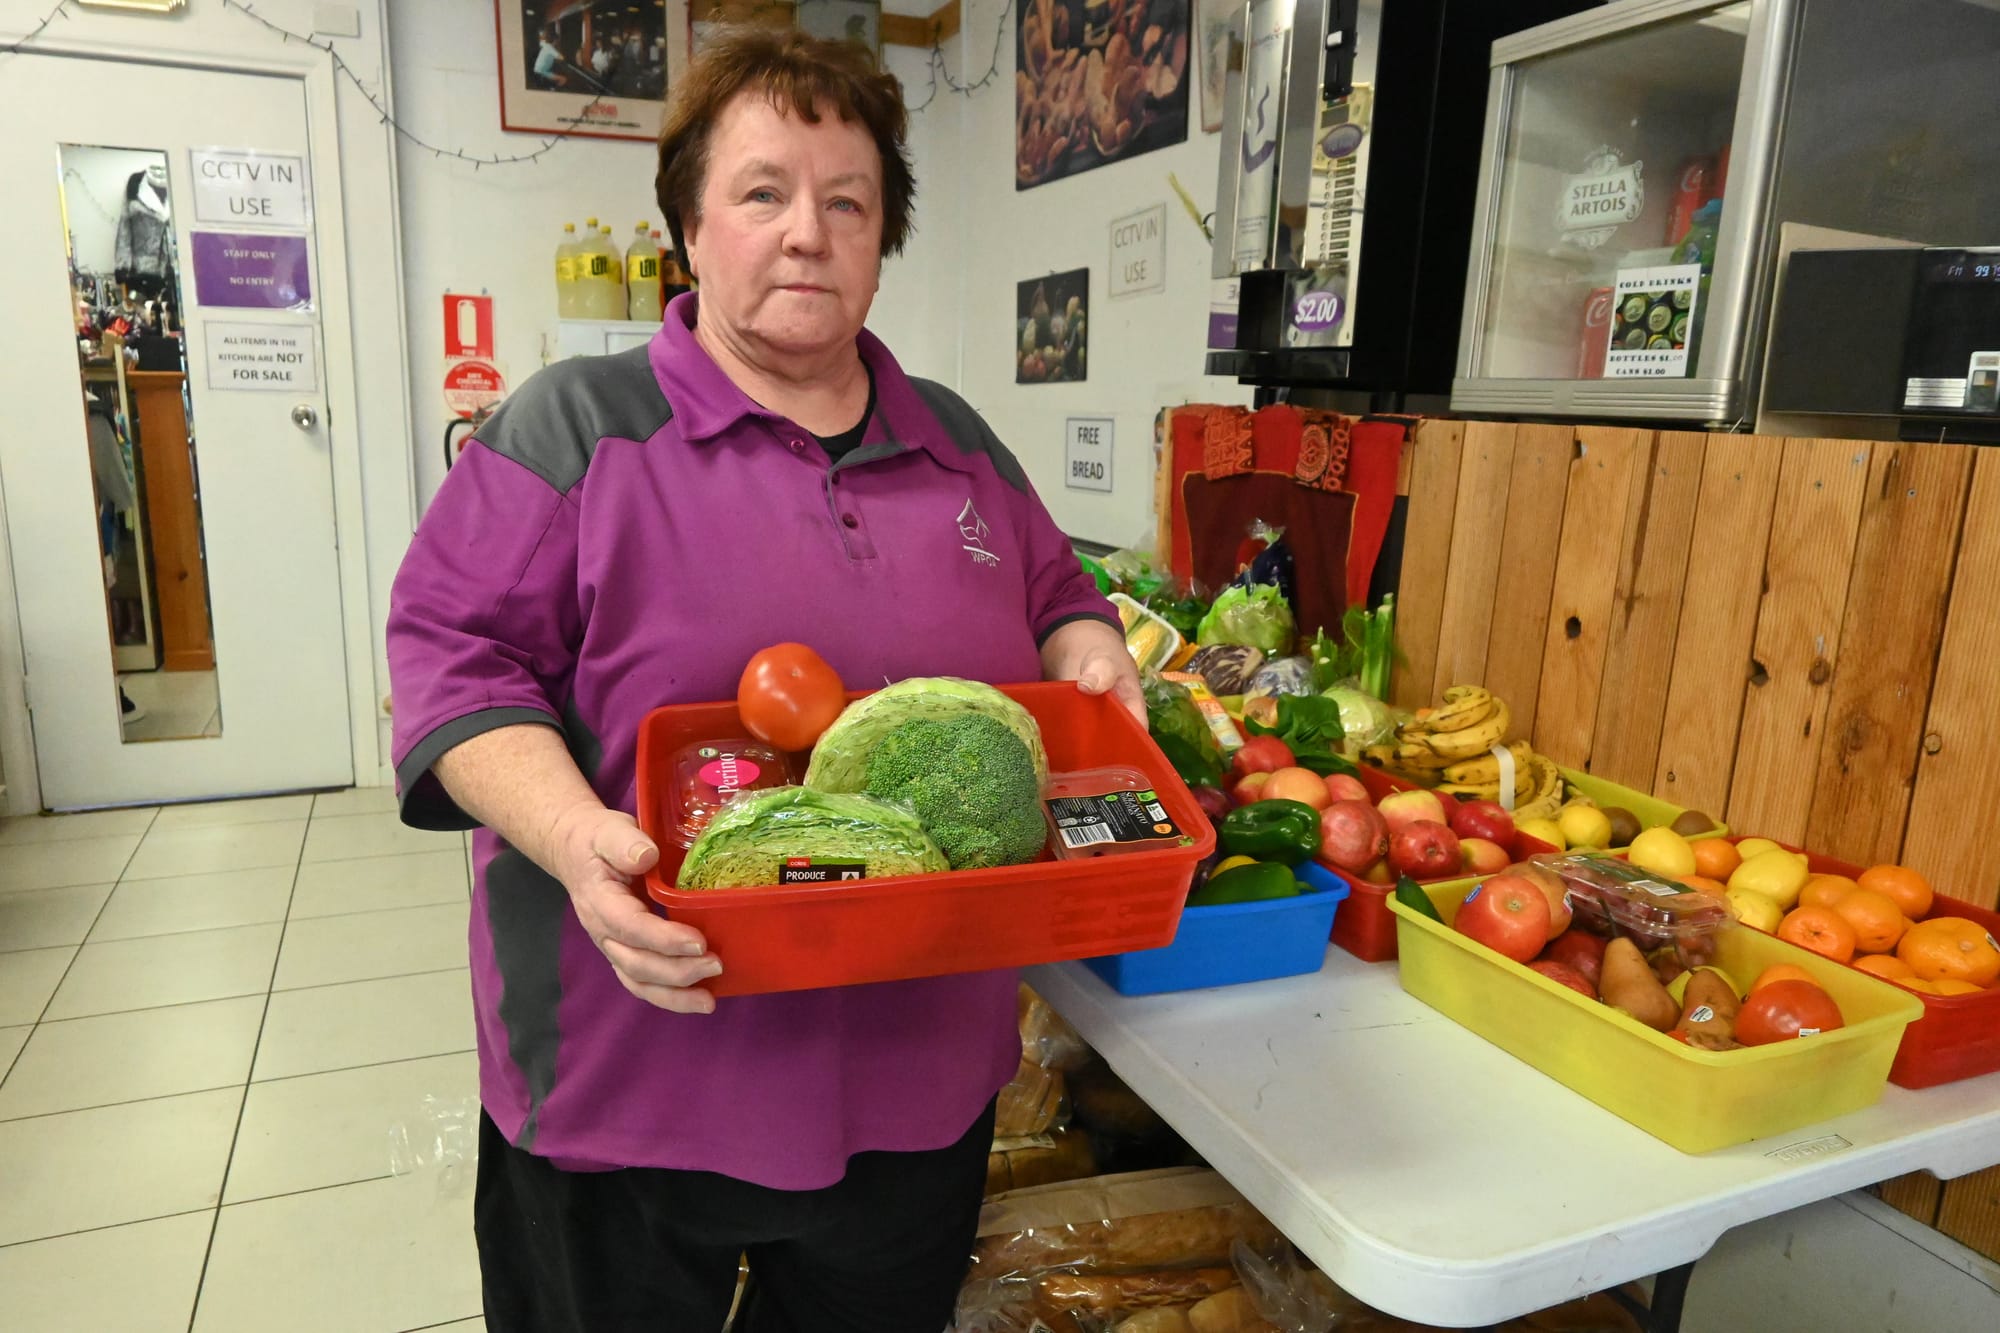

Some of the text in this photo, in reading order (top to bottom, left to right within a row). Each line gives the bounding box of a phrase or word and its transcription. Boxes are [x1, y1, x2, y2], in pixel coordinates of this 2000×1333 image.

[201, 160, 293, 183] CCTV IN
[1572, 179, 1626, 199] STELLA
[229, 197, 272, 216] USE
[1570, 196, 1626, 216] ARTOIS
[1114, 216, 1157, 248] CCTV IN
[223, 249, 276, 259] STAFF ONLY
[229, 276, 275, 286] NO ENTRY
[1124, 259, 1147, 284] USE
[1619, 277, 1692, 289] COLD DRINKS
[1295, 297, 1338, 324] $2.00
[224, 337, 238, 345] ALL
[241, 338, 267, 346] ITEMS
[281, 339, 297, 347] THE
[218, 354, 255, 362] KITCHEN
[276, 353, 304, 364] NOT
[233, 369, 293, 381] FOR SALE
[1078, 426, 1100, 445] FREE
[1072, 460, 1104, 480] BREAD
[718, 752, 740, 794] Perino
[786, 871, 826, 881] PRODUCE
